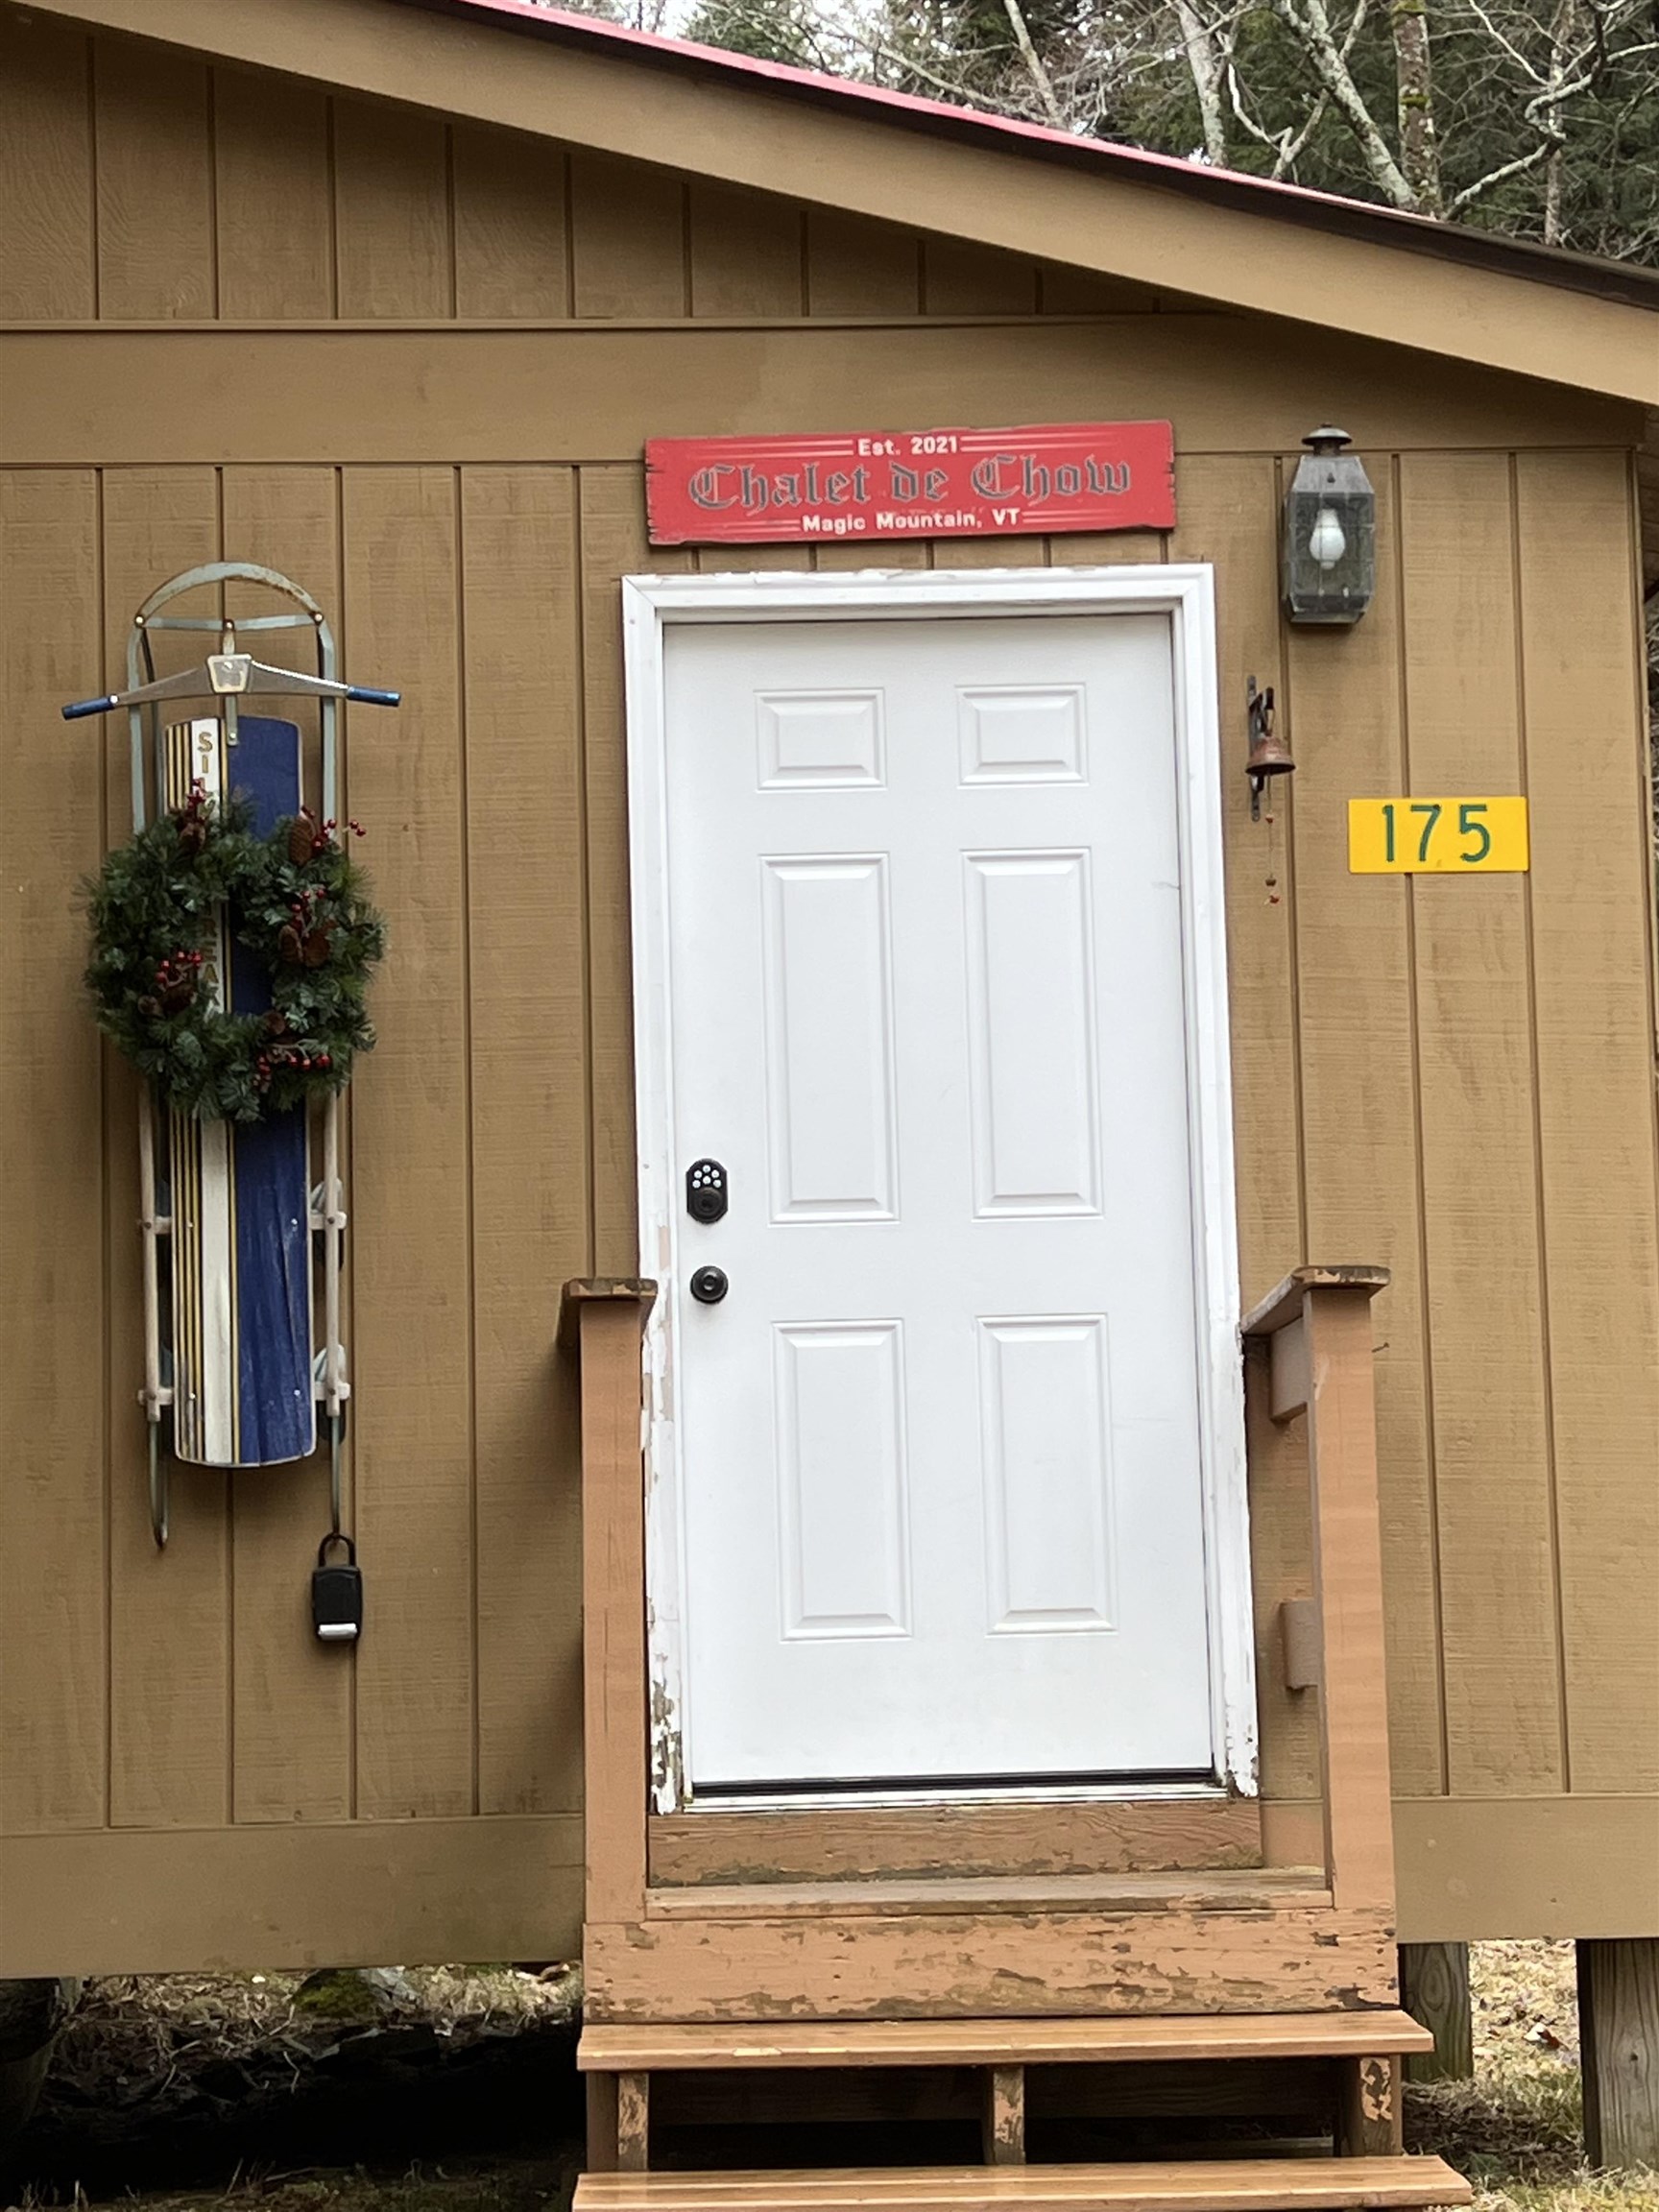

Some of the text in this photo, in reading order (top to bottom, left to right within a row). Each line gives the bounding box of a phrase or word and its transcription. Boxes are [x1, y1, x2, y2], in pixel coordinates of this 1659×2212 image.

[857, 436, 957, 456] Est. 2021
[687, 453, 1131, 517] Chalet de Chow
[802, 508, 1021, 535] Magic Mountain, VT
[1382, 804, 1491, 862] 175
